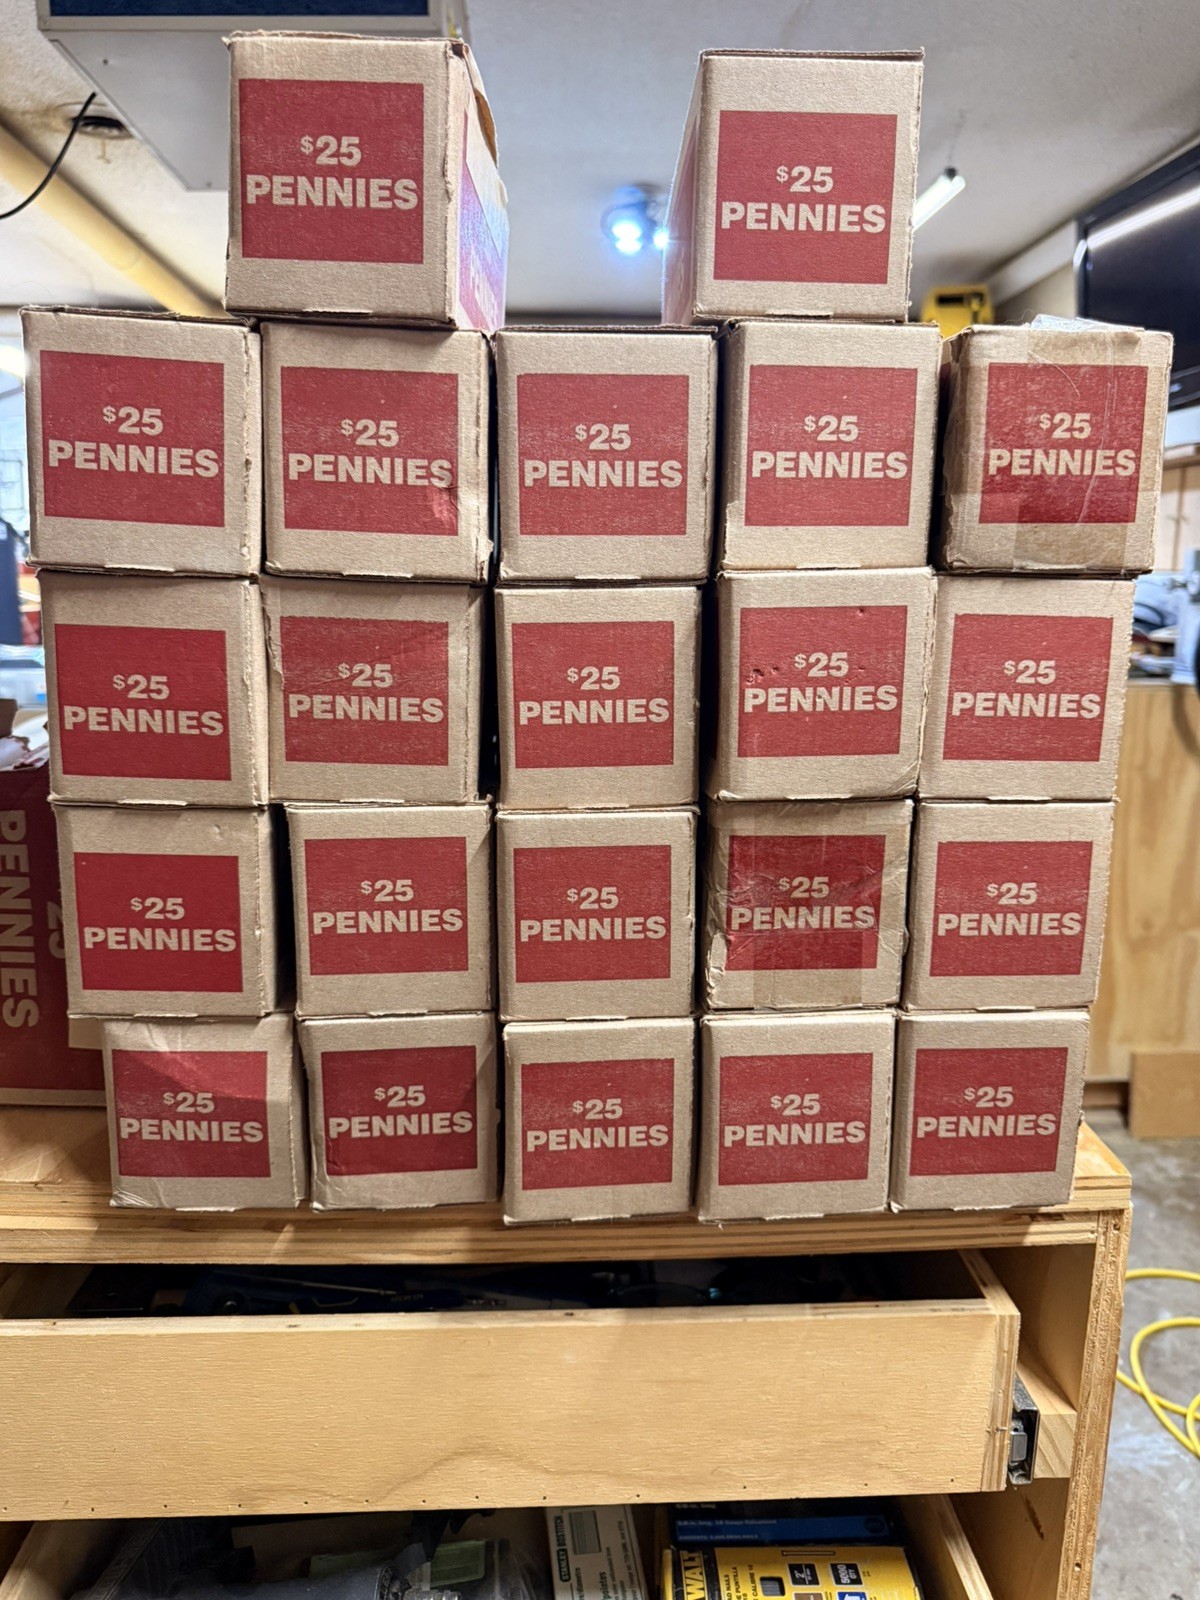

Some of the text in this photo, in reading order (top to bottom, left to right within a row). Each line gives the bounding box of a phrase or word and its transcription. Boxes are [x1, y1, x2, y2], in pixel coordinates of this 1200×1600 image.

[300, 135, 361, 166] $25
[777, 165, 833, 193] $25
[246, 175, 418, 210] PENNIES
[721, 201, 885, 233] PENNIES
[103, 406, 163, 435] $25
[341, 419, 399, 447] $25
[804, 415, 859, 442] $25
[1038, 412, 1091, 440] $25
[575, 423, 631, 450] $25
[48, 439, 219, 477] PENNIES
[288, 453, 451, 488] PENNIES
[752, 451, 907, 478] PENNIES
[988, 448, 1137, 477] PENNIES
[524, 460, 682, 488] PENNIES
[338, 663, 393, 688] $25
[795, 652, 849, 677] $25
[1003, 660, 1056, 684] $25
[113, 675, 169, 700] $25
[567, 666, 620, 690] $25
[289, 694, 443, 723] PENNIES
[519, 698, 669, 725] PENNIES
[744, 685, 897, 712] PENNIES
[952, 692, 1100, 718] PENNIES
[64, 706, 223, 736] PENNIES
[361, 880, 414, 902] $25
[567, 887, 618, 909] $25
[779, 877, 829, 899] $25
[987, 882, 1039, 906] $25
[0, 809, 40, 1028] PENNIES
[131, 897, 185, 920] $25
[313, 909, 462, 934] PENNIES
[730, 906, 877, 933] PENNIES
[520, 916, 666, 942] PENNIES
[938, 913, 1081, 936] PENNIES
[84, 927, 236, 952] PENNIES
[163, 1092, 214, 1113] $25
[375, 1085, 426, 1108] $25
[572, 1098, 623, 1120] $25
[771, 1094, 820, 1116] $25
[964, 1087, 1013, 1108] $25
[119, 1118, 263, 1142] PENNIES
[329, 1112, 472, 1138] PENNIES
[724, 1121, 865, 1147] PENNIES
[917, 1114, 1056, 1138] PENNIES
[527, 1125, 668, 1152] PENNIES
[836, 1564, 851, 1583] 5000
